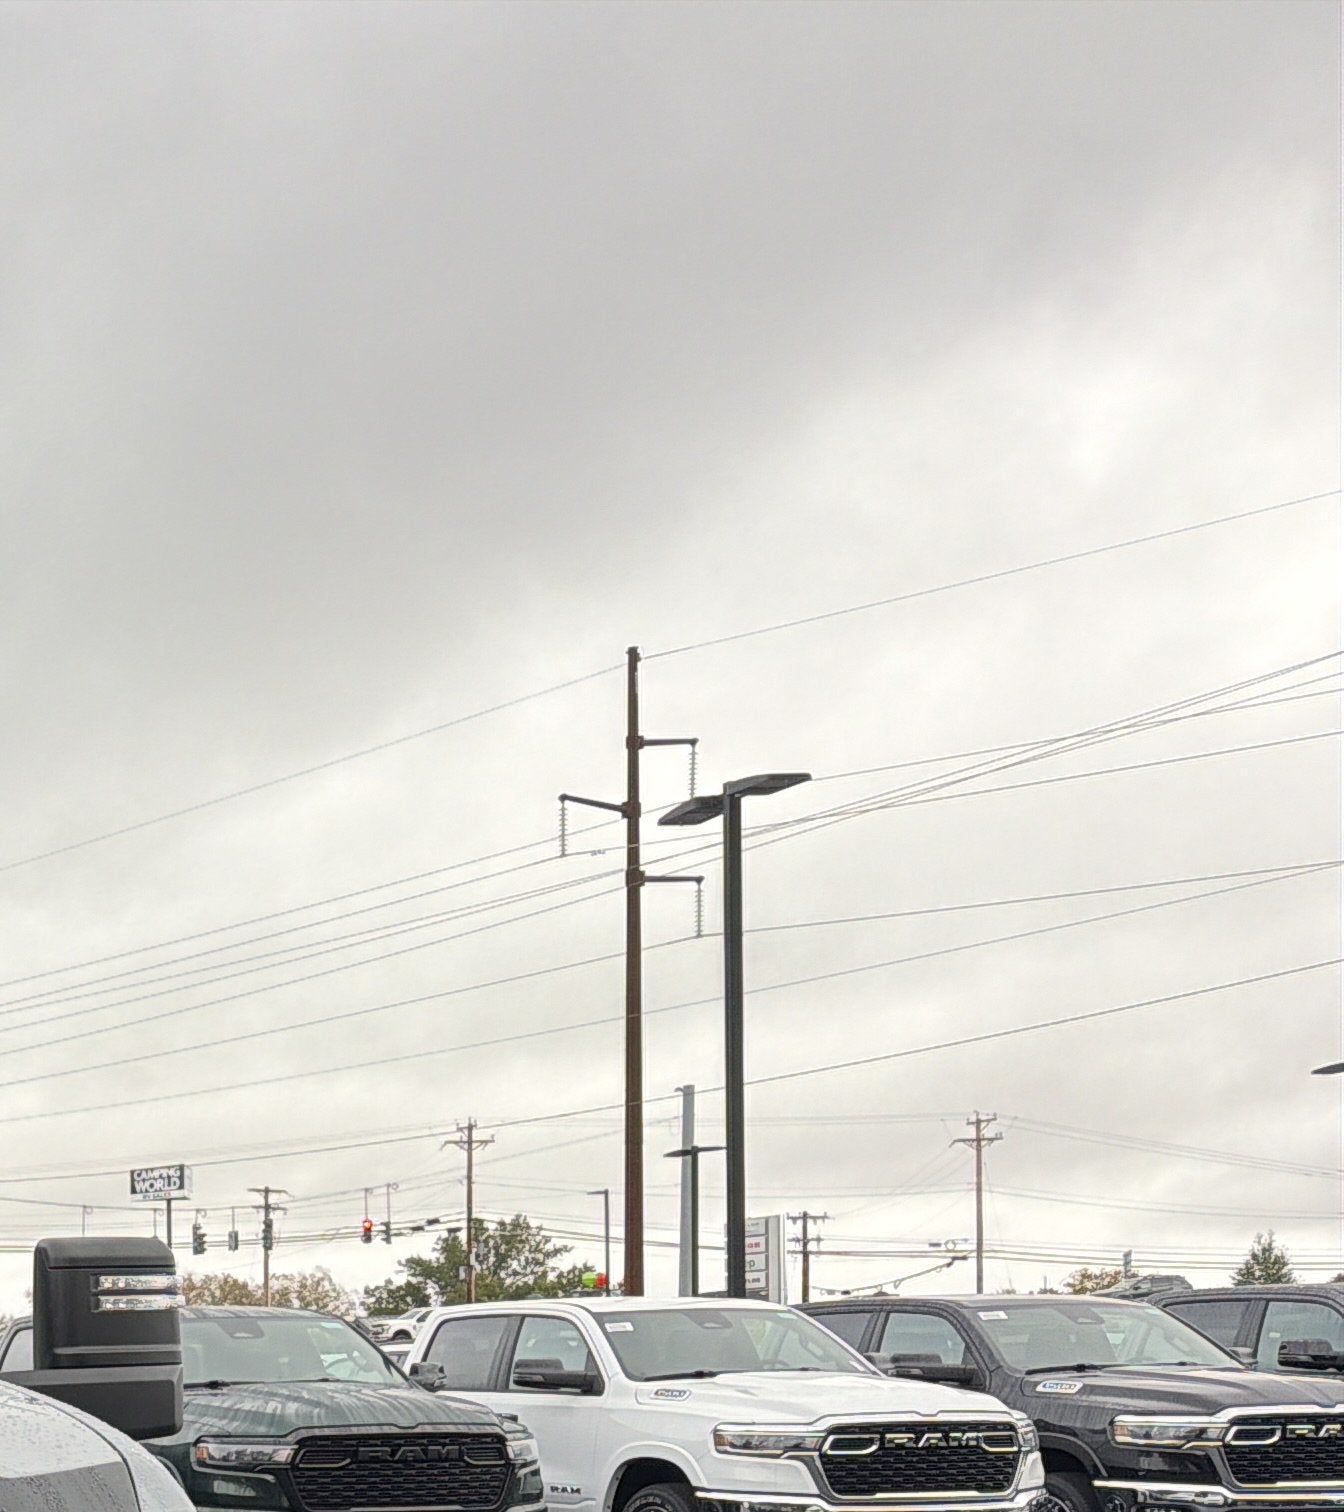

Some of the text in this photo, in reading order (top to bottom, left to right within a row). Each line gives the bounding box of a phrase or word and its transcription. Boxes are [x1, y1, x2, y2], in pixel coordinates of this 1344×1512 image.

[133, 1166, 181, 1181] CAMPING
[133, 1177, 181, 1193] WORLD
[885, 1432, 984, 1448] RAM
[358, 1446, 459, 1461] RAM
[550, 1485, 581, 1494] RAM
